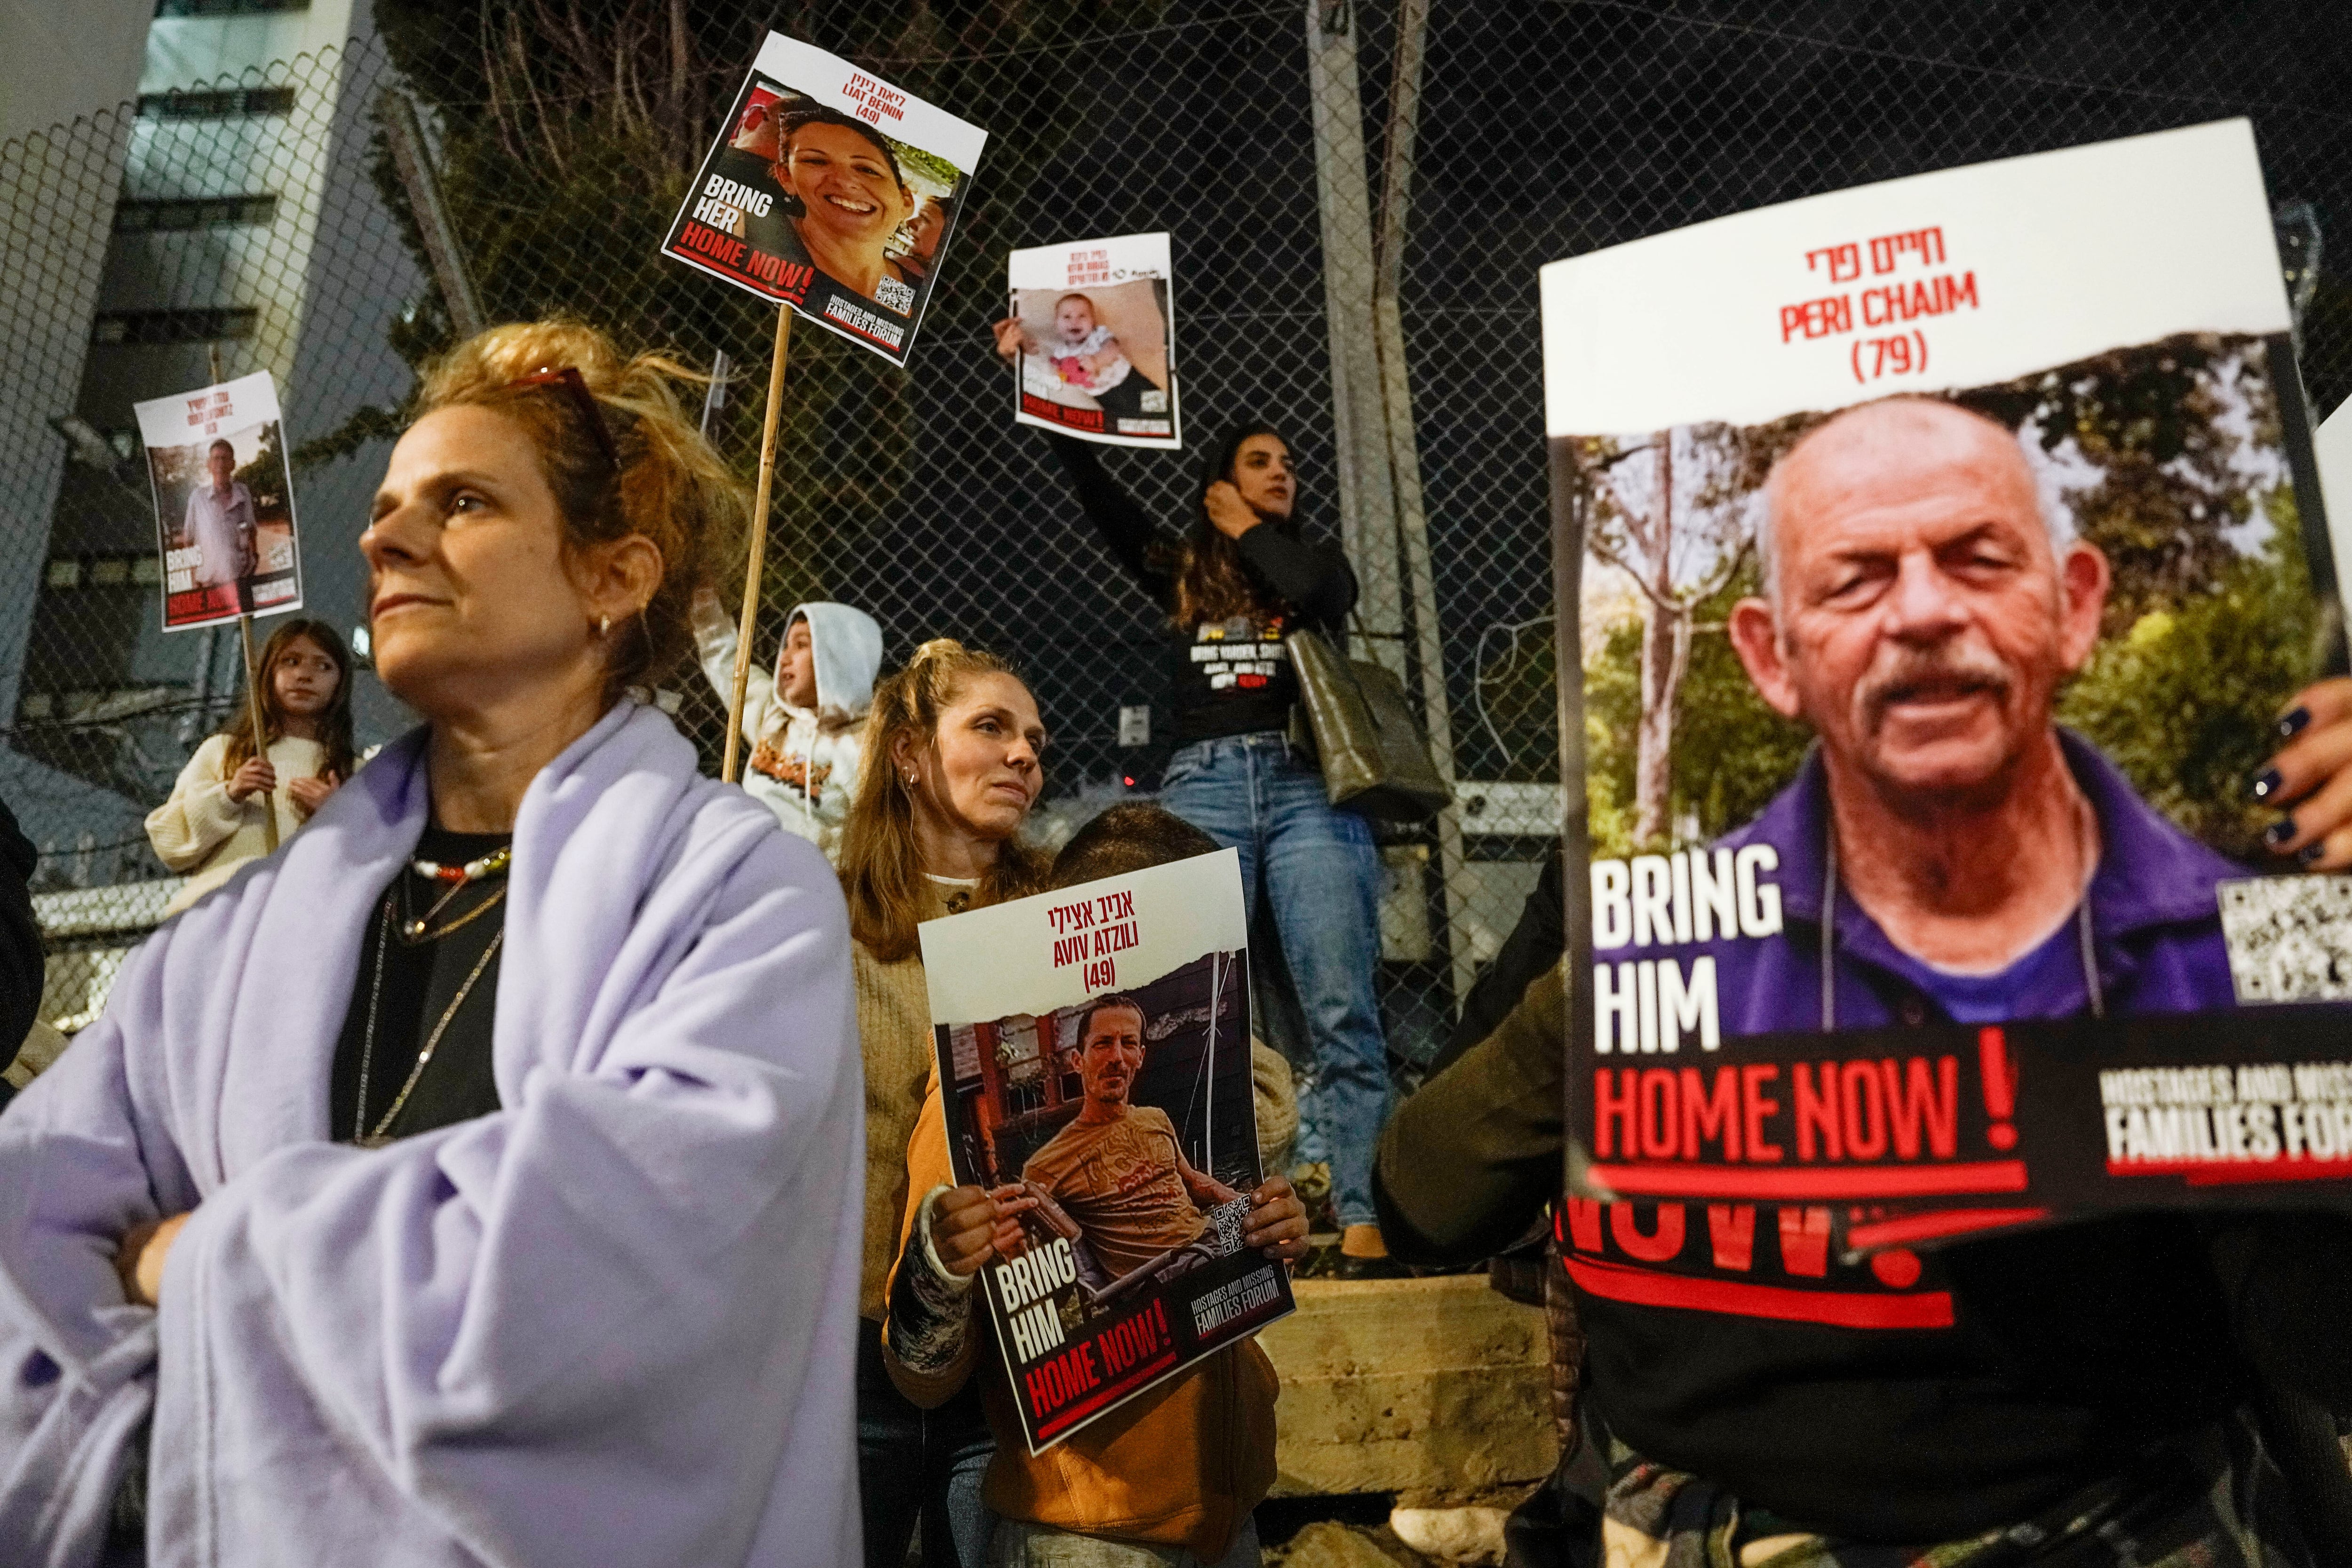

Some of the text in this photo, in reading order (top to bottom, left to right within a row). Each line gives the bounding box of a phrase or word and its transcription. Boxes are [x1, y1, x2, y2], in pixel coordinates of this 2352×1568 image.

[842, 83, 905, 121] LIAT BEININ
[850, 73, 906, 107] ליאת בינין
[856, 103, 881, 125] (49)
[692, 195, 739, 234] HER
[703, 173, 773, 218] BRING
[681, 221, 815, 294] HOME NOW!
[1804, 225, 1947, 284] חיים פרי
[826, 302, 902, 349] FAMILIES FORUM
[830, 294, 905, 337] HOSTAGES AND MISSING
[1780, 270, 1980, 344] PERI CHAIM
[1850, 328, 1929, 385] (79)
[1047, 890, 1136, 935] אביב אצילי
[1590, 843, 1784, 951] BRING
[1054, 921, 1139, 968] AVIV ATZILI
[1084, 957, 1115, 994] (49)
[1593, 955, 1721, 1054] HIM
[1593, 1063, 1784, 1162] HOME
[2104, 1104, 2281, 1163] FAMILIES
[995, 1237, 1077, 1314] BRING
[1191, 1265, 1274, 1315] HOSTAGES AND MISSING
[1009, 1297, 1065, 1365] HIM
[1195, 1278, 1279, 1336] FAMILIES FORUM
[1025, 1297, 1171, 1418] HOME NOW!
